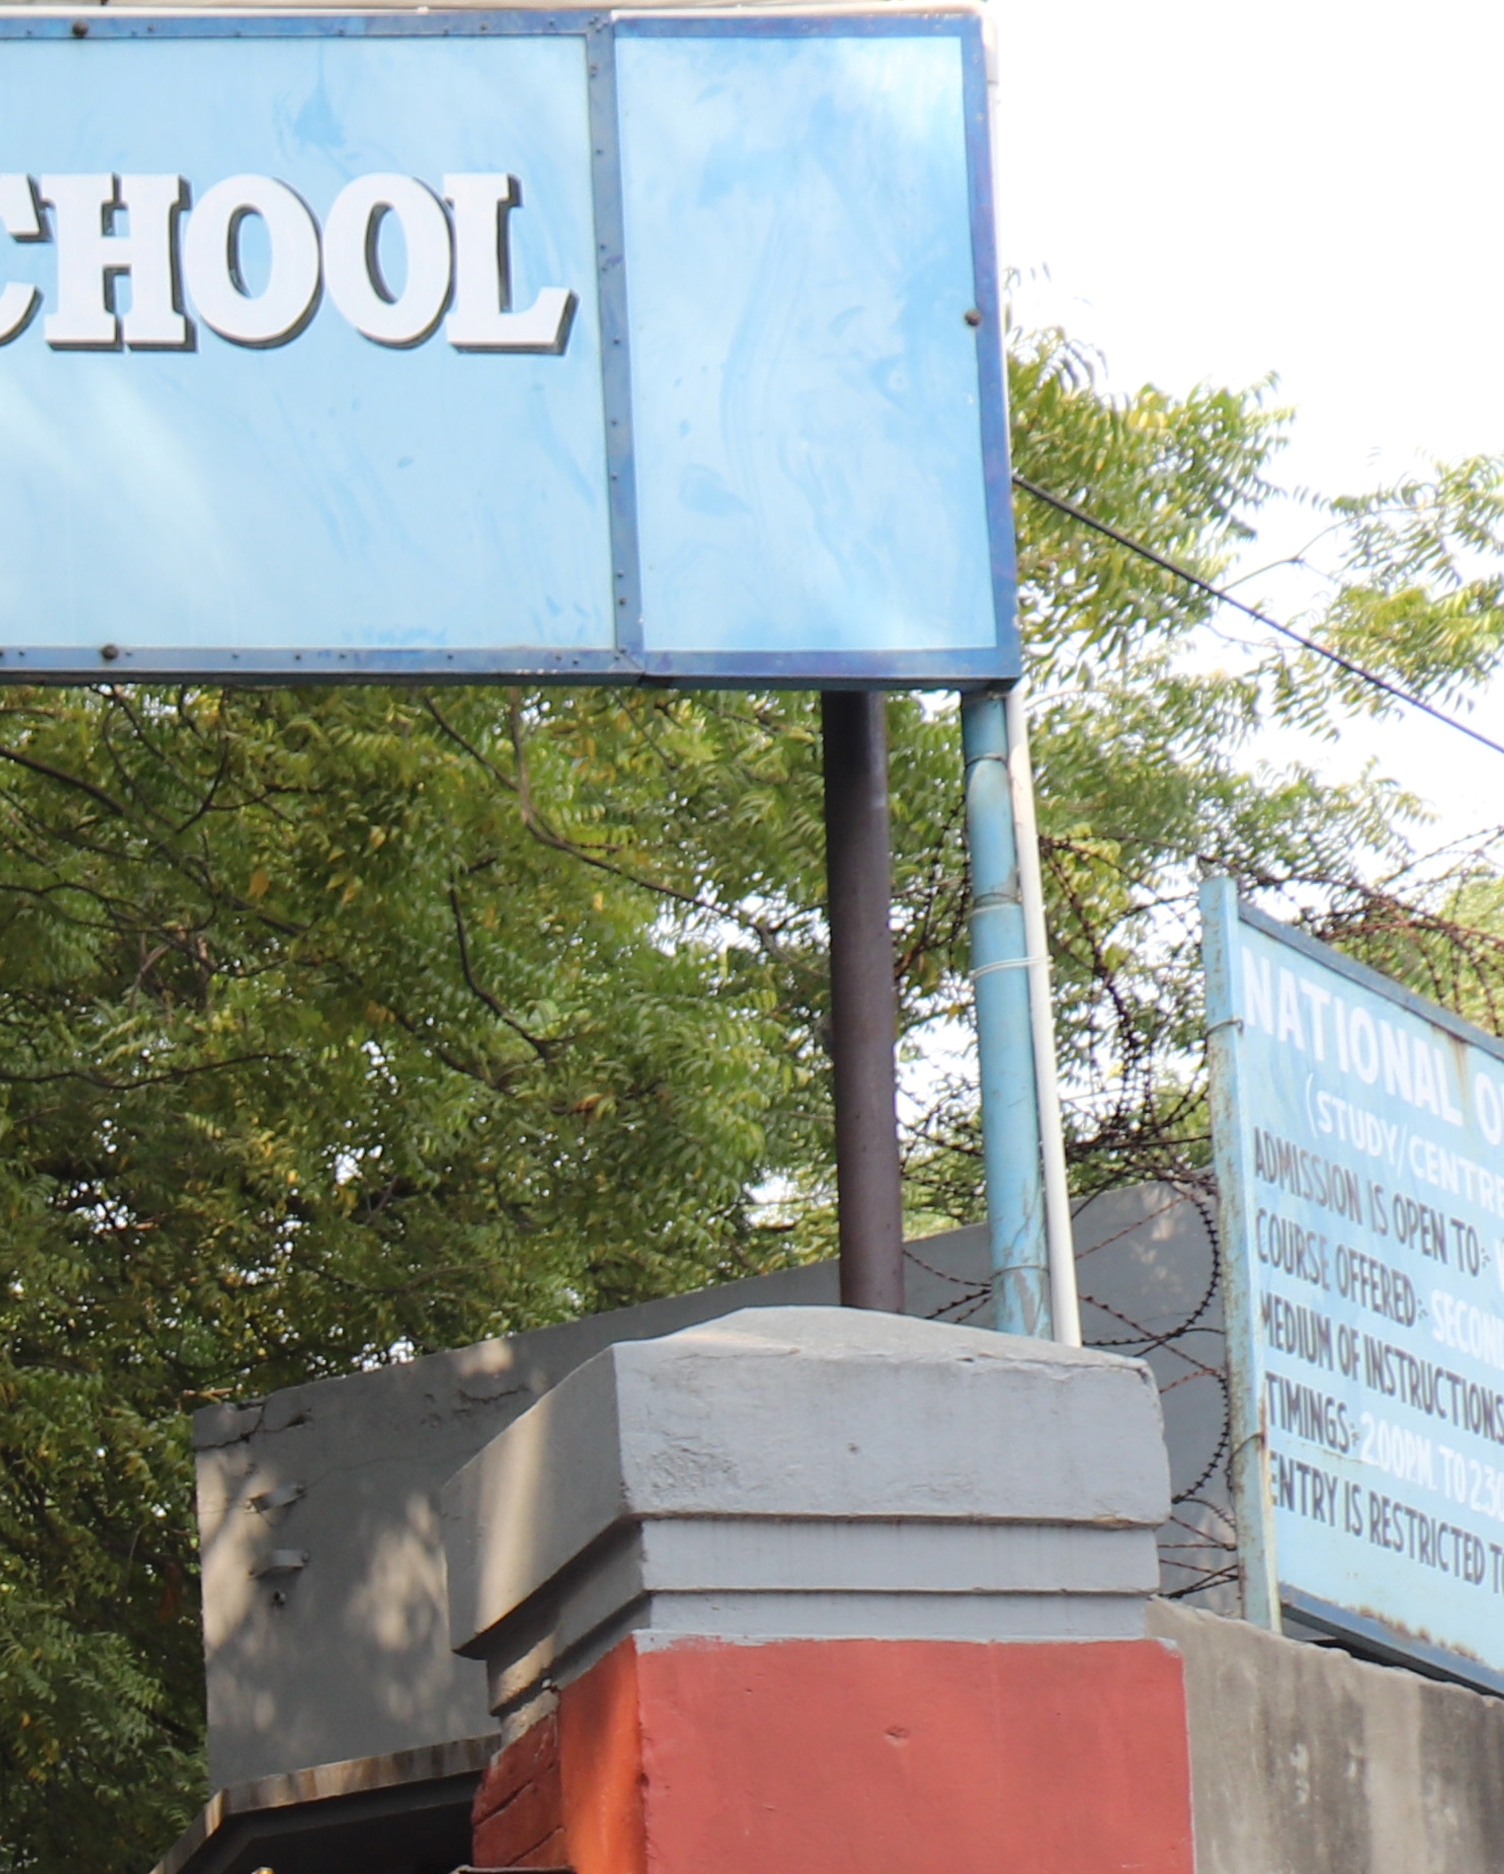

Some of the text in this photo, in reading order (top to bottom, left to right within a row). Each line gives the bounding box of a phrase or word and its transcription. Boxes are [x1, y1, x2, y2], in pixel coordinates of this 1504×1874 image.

[1241, 944, 1464, 1128] NATIONAL
[1254, 1125, 1364, 1226] ADMISSION
[1368, 1180, 1388, 1237] IS
[1391, 1192, 1448, 1265] OPEN
[1255, 1206, 1331, 1292] COURSE
[1430, 1288, 1504, 1370] SECON
[1260, 1290, 1504, 1446] MEDIUM OF INSTRUCTIONS
[1344, 1480, 1364, 1538] IS
[1369, 1489, 1486, 1586] RESTRICTED
[1438, 1444, 1467, 1504] TO
